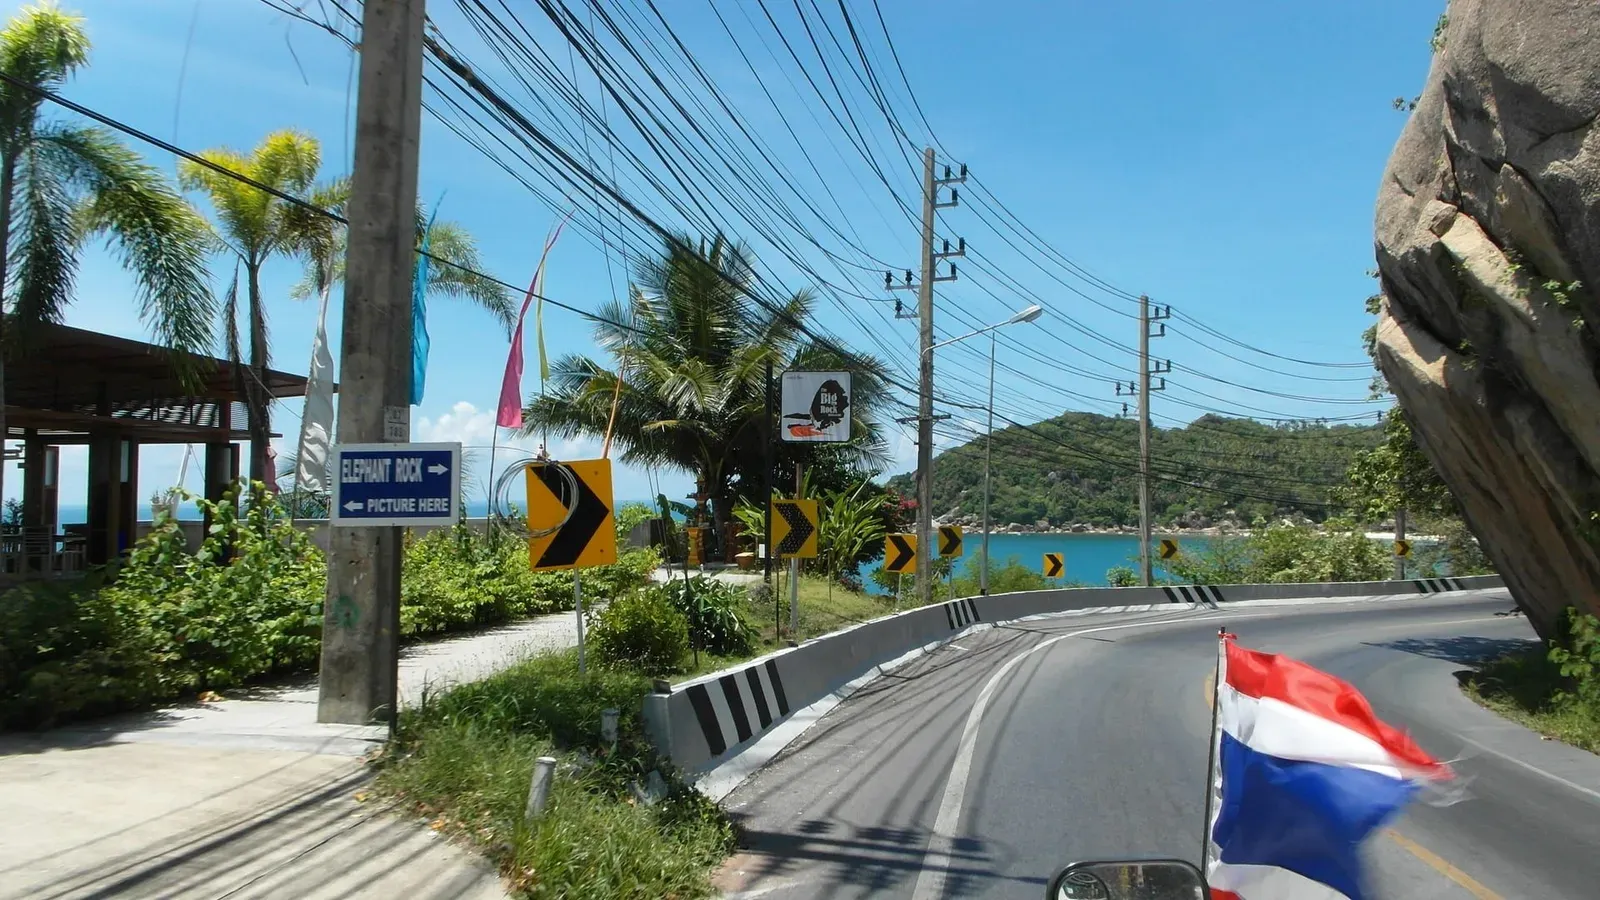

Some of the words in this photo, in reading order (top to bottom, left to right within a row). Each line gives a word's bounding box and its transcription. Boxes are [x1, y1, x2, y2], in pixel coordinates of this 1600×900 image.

[821, 393, 837, 405] Big
[820, 405, 838, 414] Rock
[342, 458, 392, 483] ELEPHANT
[395, 458, 423, 482] ROCK
[367, 498, 416, 513] PICTURE
[418, 498, 449, 512] HERE
